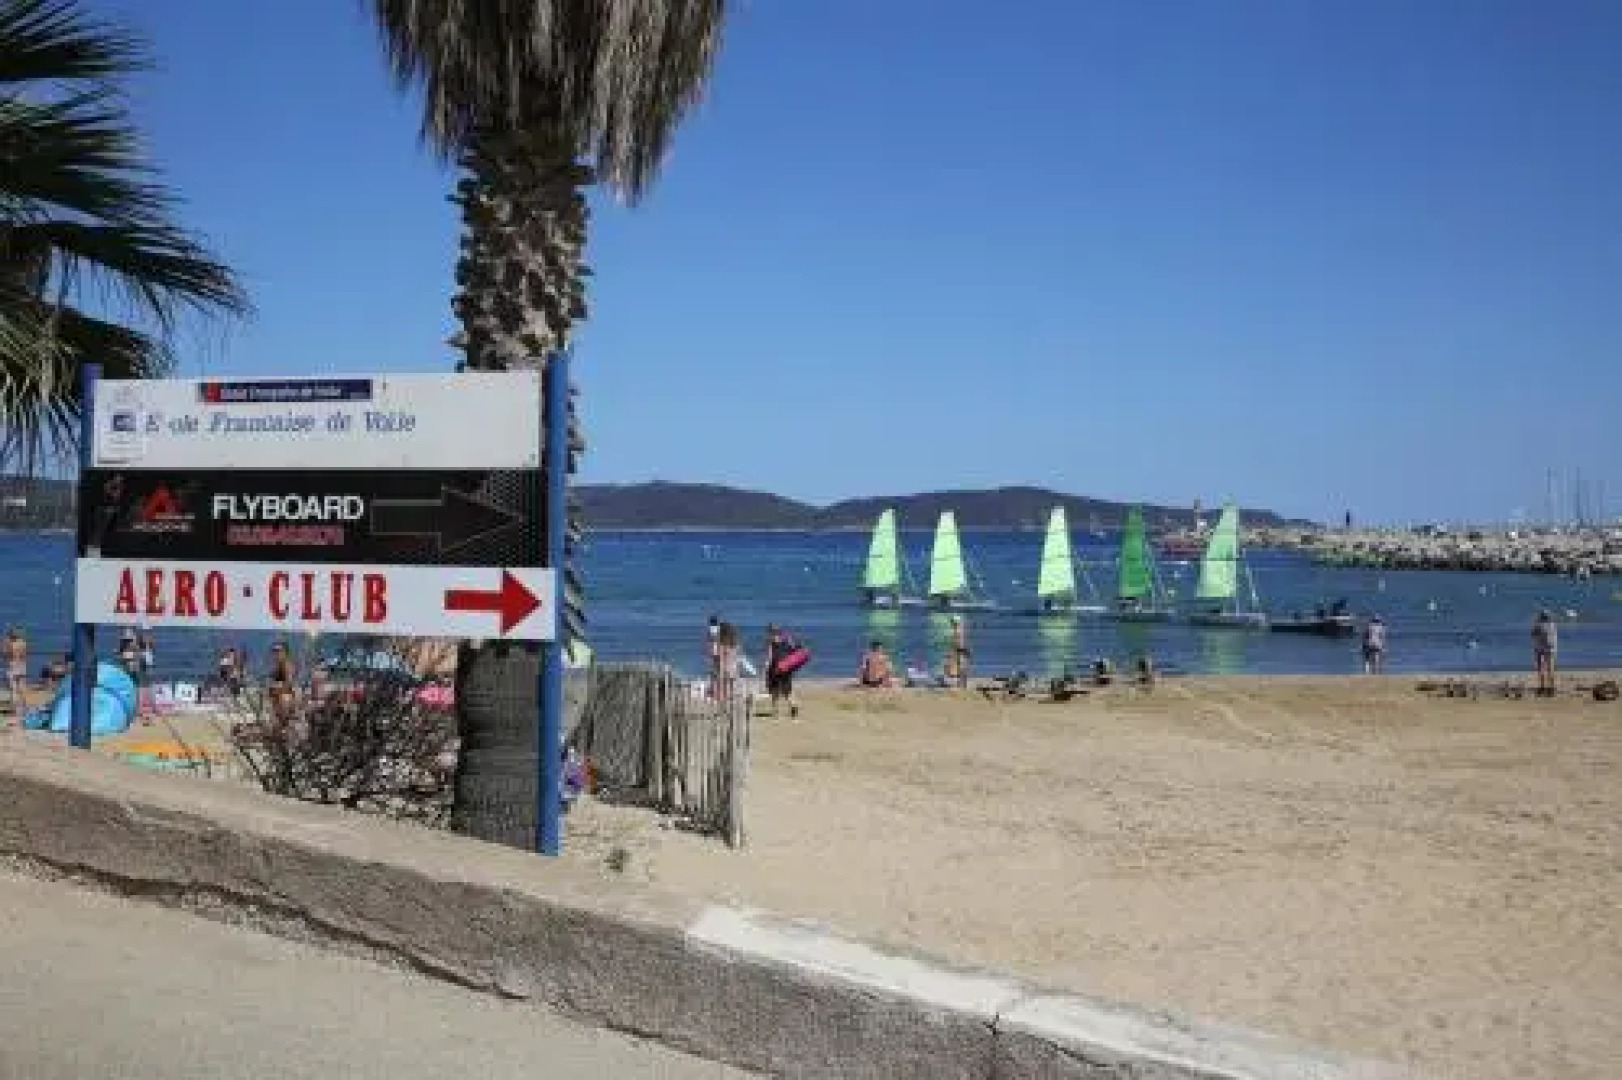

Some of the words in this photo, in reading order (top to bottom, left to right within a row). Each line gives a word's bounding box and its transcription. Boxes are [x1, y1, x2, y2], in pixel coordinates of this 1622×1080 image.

[146, 413, 199, 433] Eole
[327, 411, 350, 431] de
[212, 493, 364, 520] FLYBOARD
[114, 567, 228, 616] AERO
[268, 570, 387, 623] CLUB
